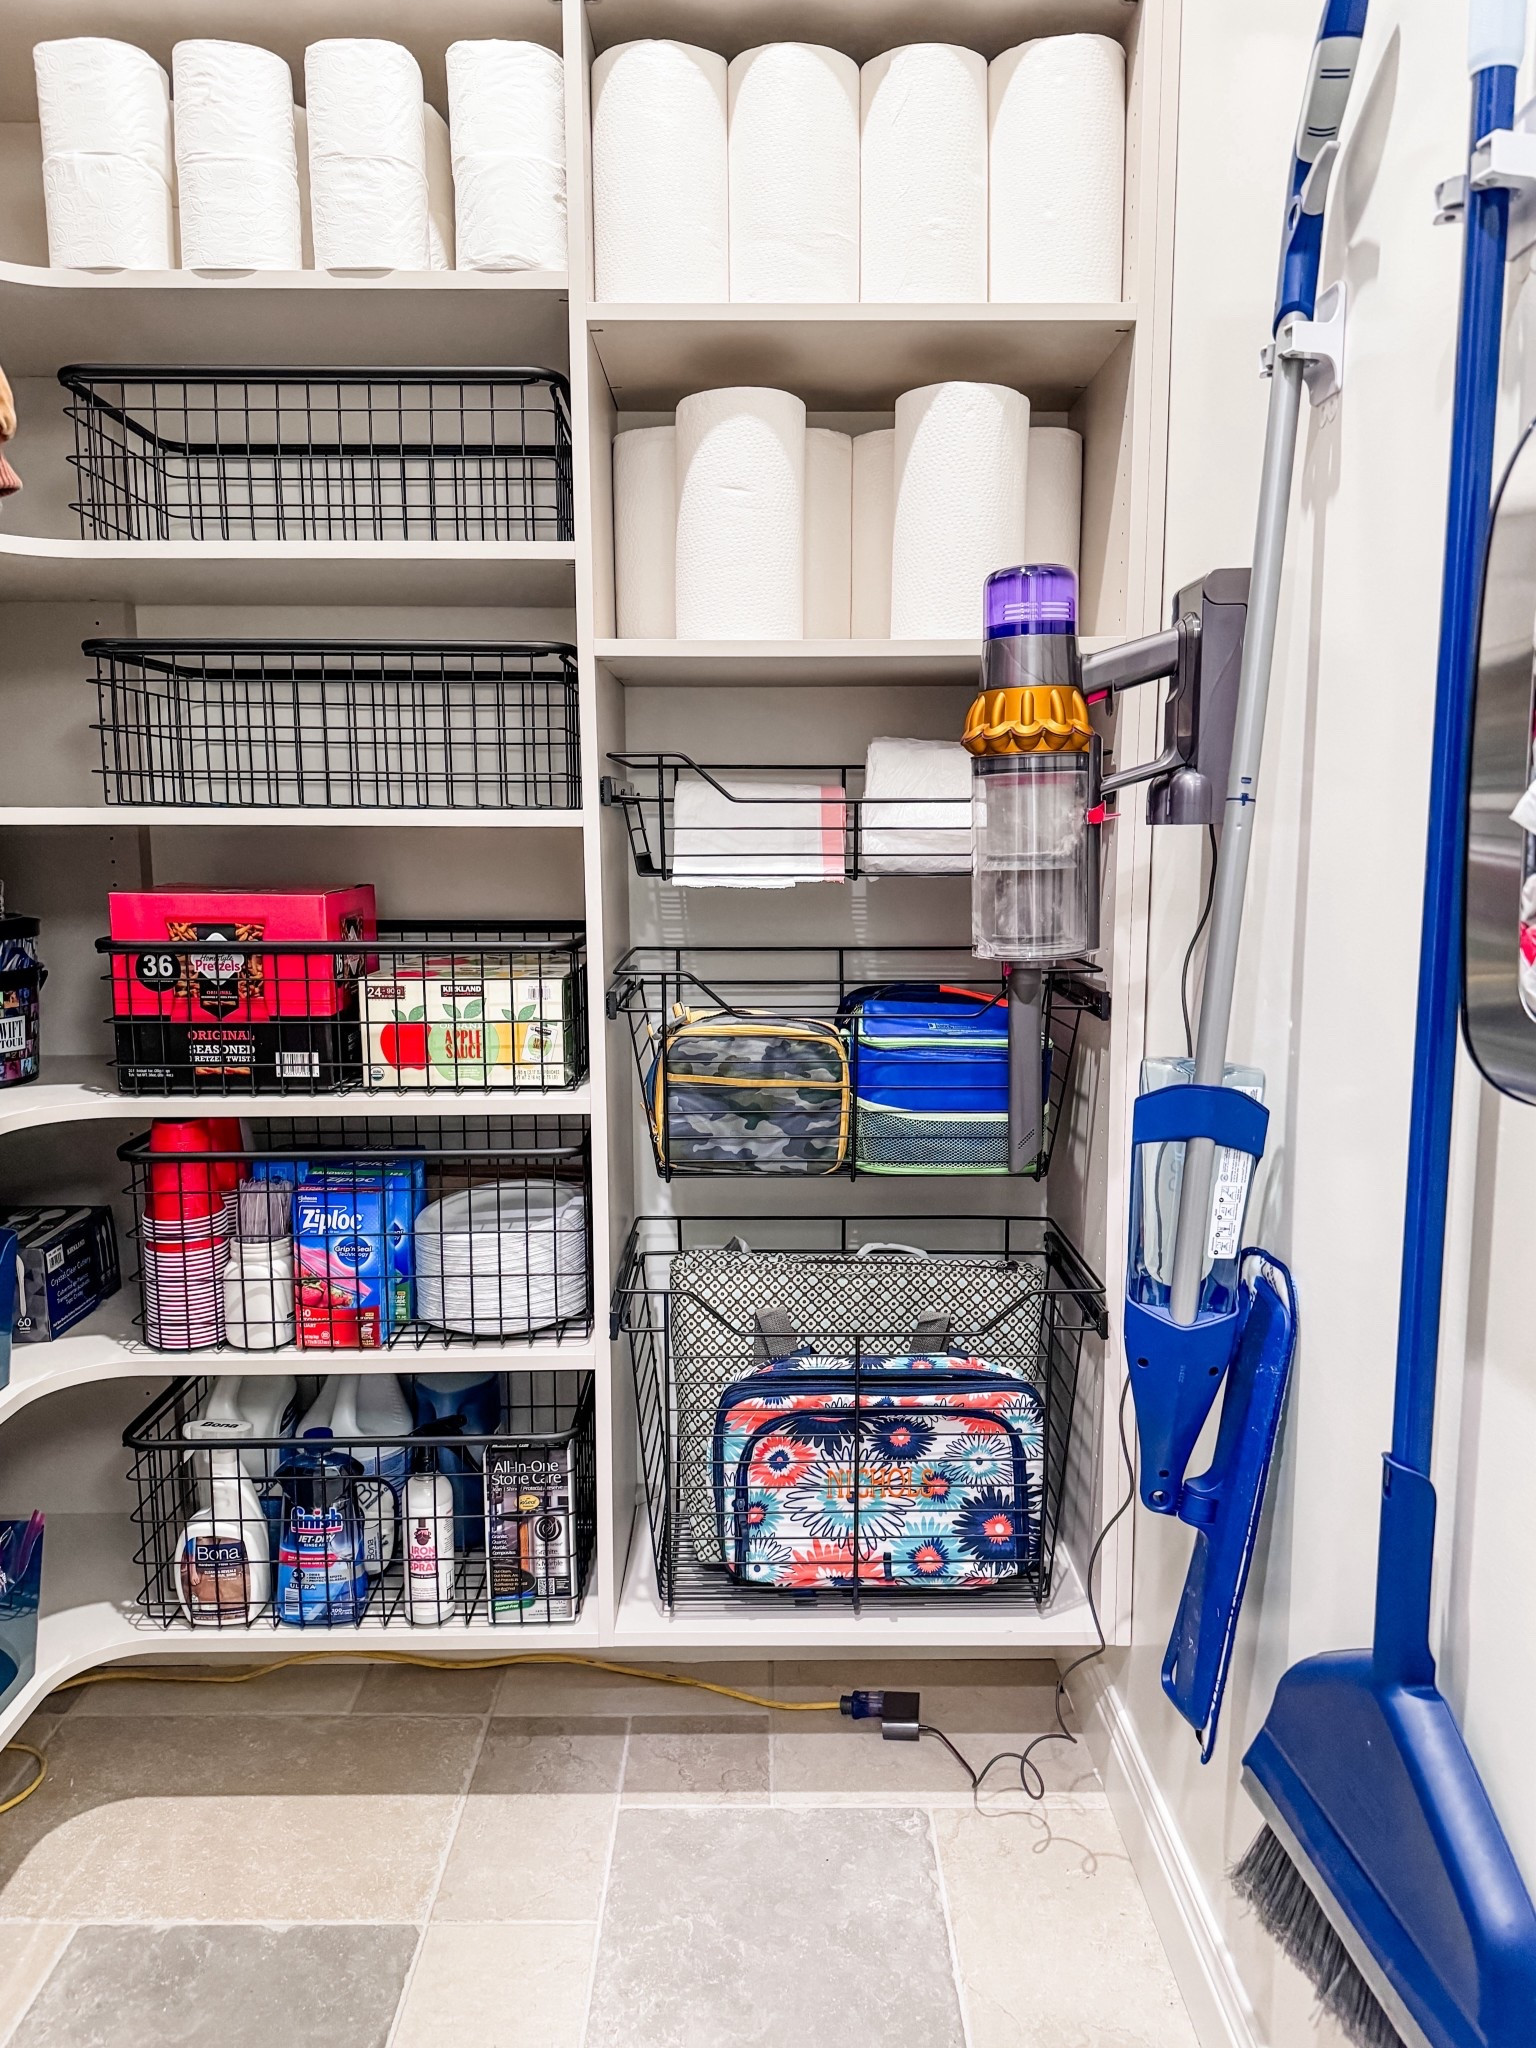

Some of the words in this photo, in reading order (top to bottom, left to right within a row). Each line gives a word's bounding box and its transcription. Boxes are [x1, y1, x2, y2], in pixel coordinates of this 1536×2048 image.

[143, 954, 173, 976] 36
[367, 986, 382, 998] 24
[188, 1030, 256, 1040] ORIGINAL
[445, 1030, 482, 1044] APPLE
[0, 1038, 22, 1049] TOUR
[189, 1045, 256, 1054] SEASONED
[445, 1044, 482, 1058] SAUCE
[302, 1208, 363, 1234] Ziploc
[18, 1317, 31, 1327] 60
[494, 1460, 559, 1473] All-In-One
[492, 1474, 530, 1486] Stone
[532, 1474, 561, 1484] Care
[826, 1468, 934, 1498] NICHOLS
[197, 1546, 240, 1560] Bona
[412, 1546, 435, 1555] IRON
[410, 1562, 436, 1571] SPRAY
